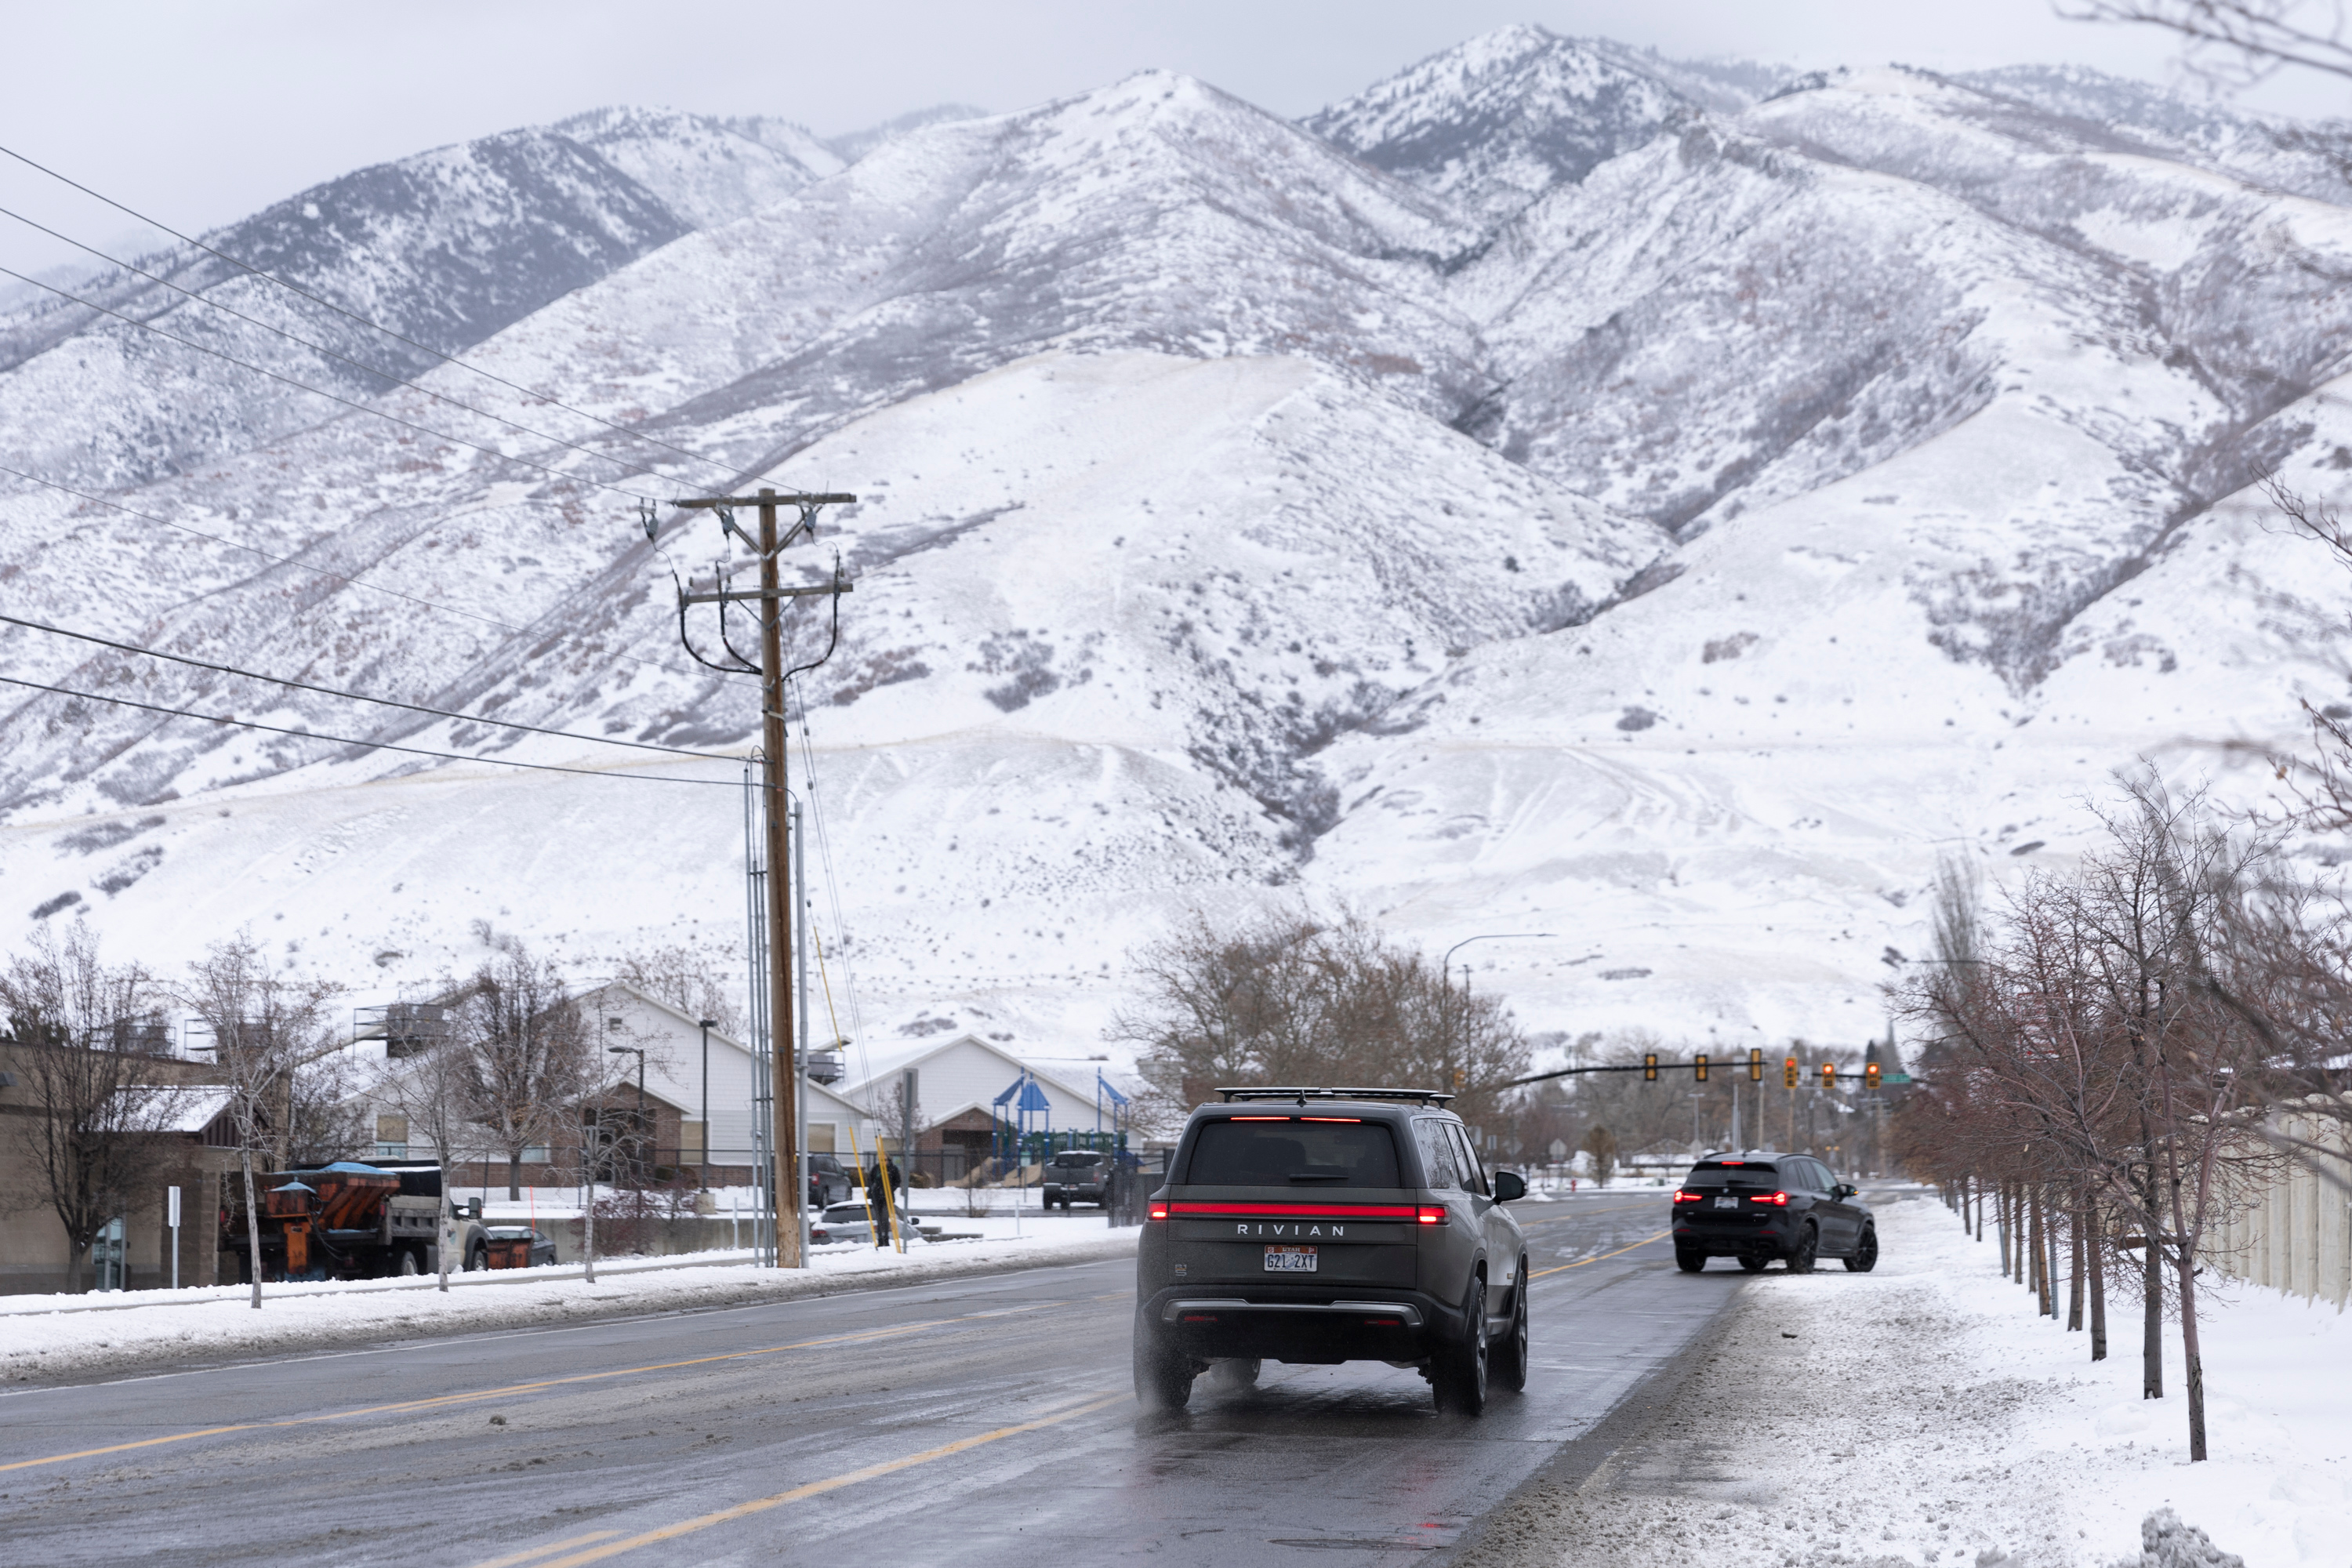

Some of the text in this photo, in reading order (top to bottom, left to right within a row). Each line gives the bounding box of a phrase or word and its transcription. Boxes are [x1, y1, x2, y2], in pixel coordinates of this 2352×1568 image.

[1237, 1224, 1344, 1236] RIVIAN
[1267, 1254, 1315, 1268] G21 2XT
